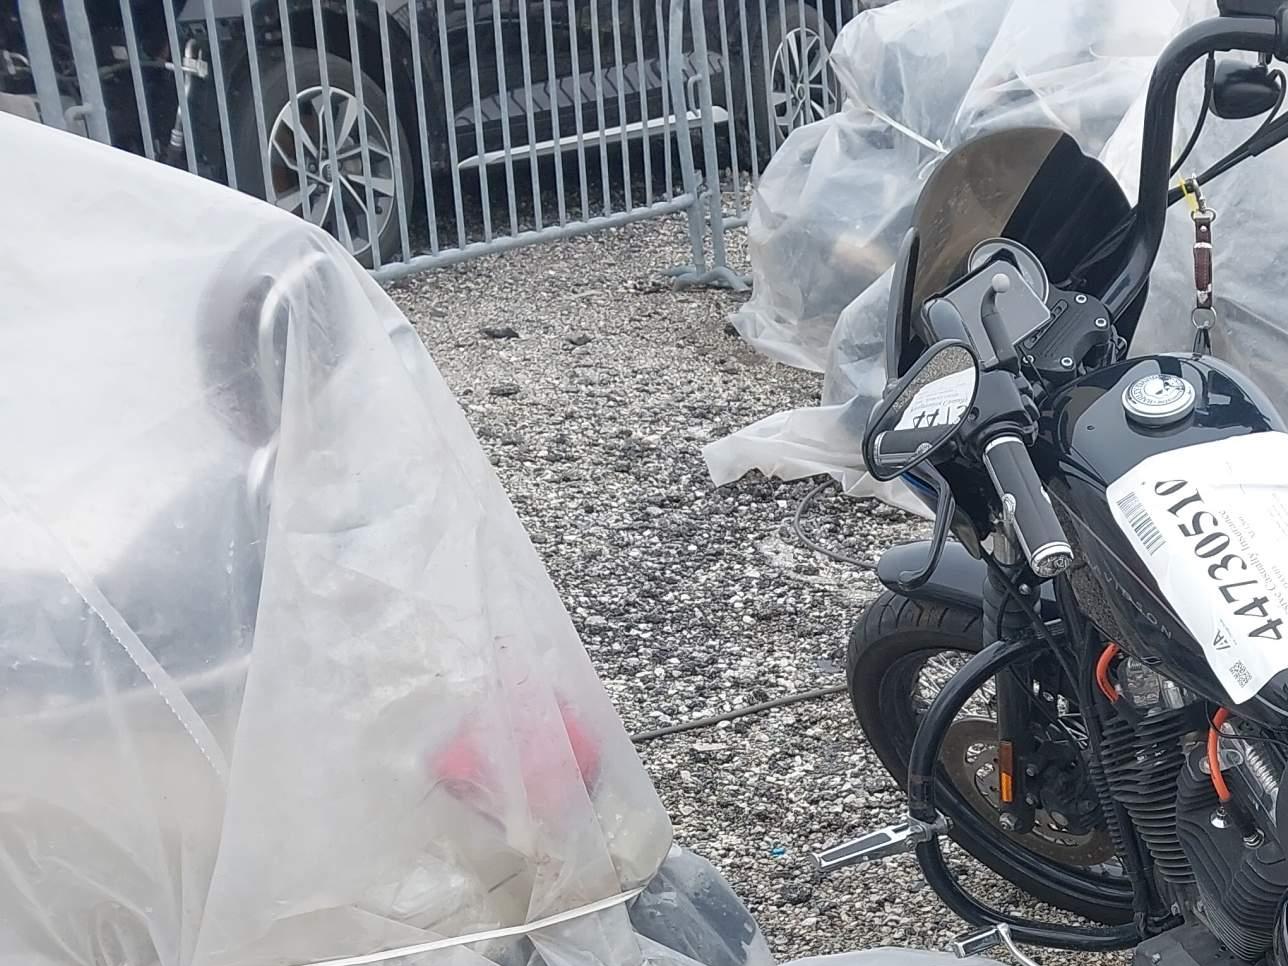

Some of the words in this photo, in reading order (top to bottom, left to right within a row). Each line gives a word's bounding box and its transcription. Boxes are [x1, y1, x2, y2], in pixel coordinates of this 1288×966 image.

[1218, 510, 1249, 552] Insurance
[1154, 479, 1284, 640] 44730510
[1247, 551, 1277, 591] Casualty
